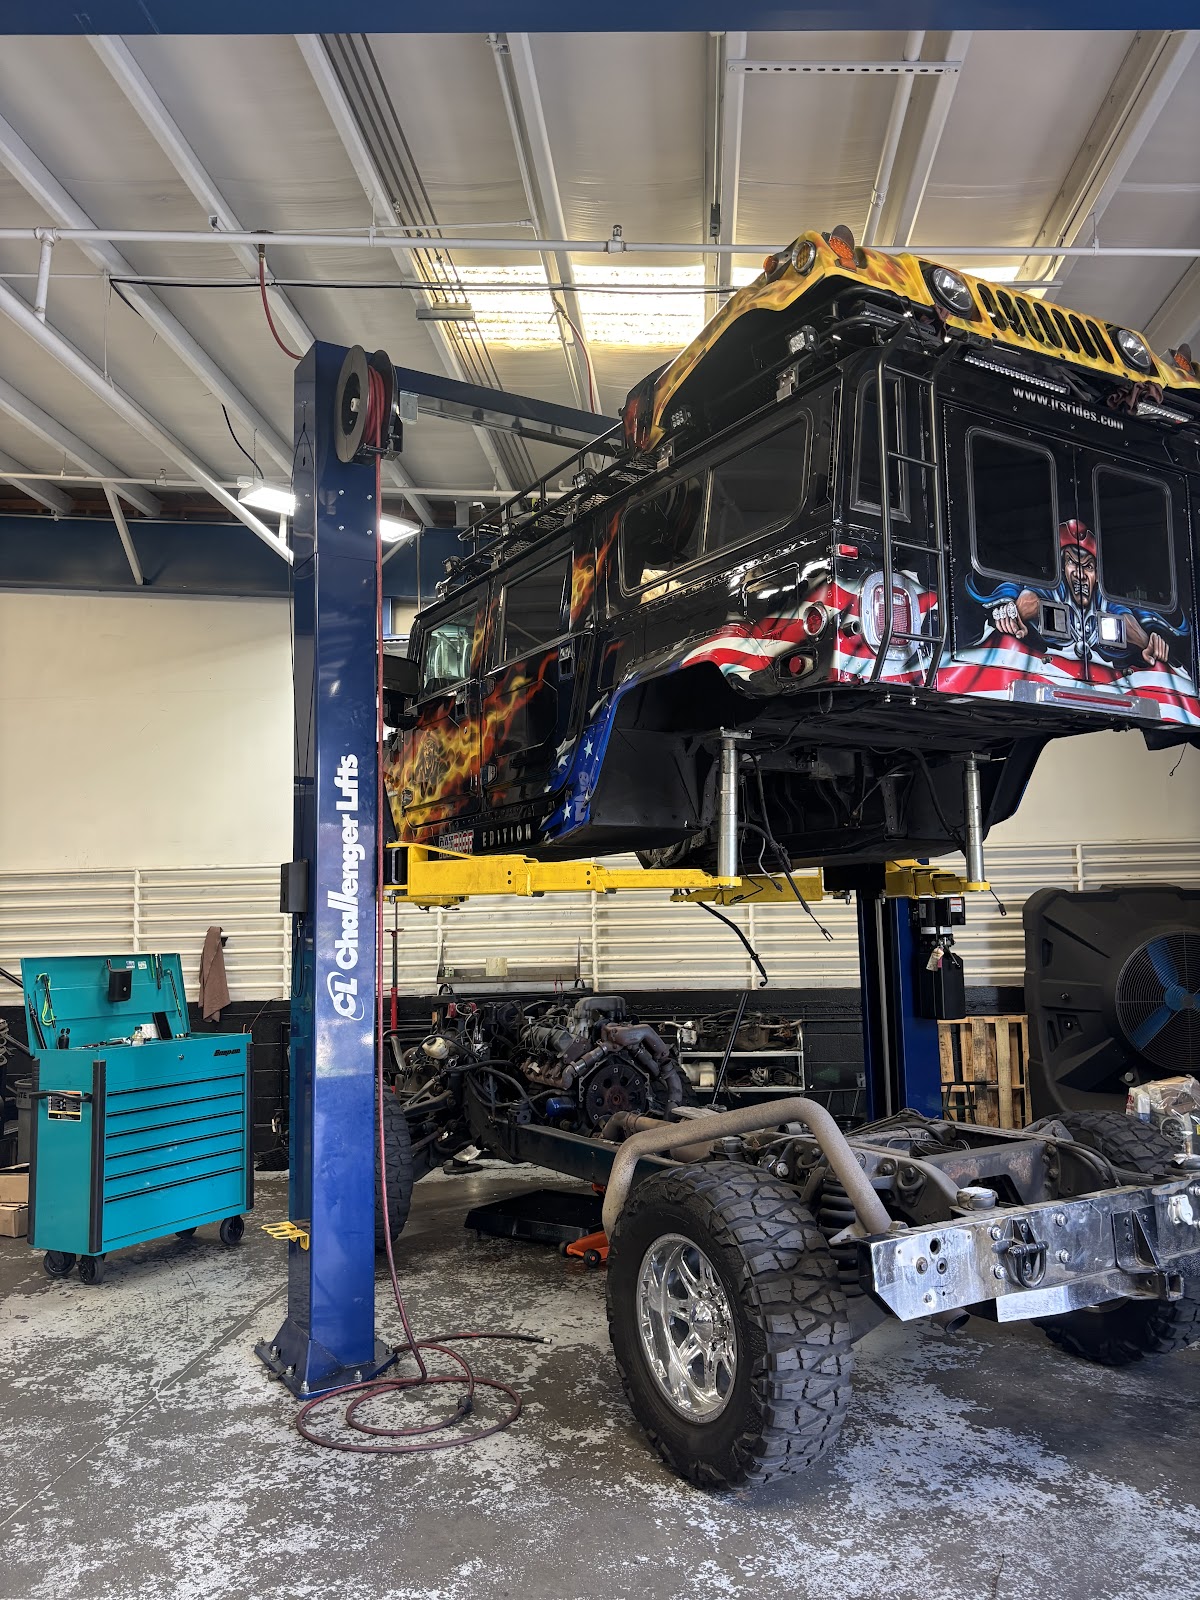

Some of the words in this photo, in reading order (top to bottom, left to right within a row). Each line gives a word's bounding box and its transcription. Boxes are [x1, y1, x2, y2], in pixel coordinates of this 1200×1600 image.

[1012, 387, 1124, 430] www.jrsrides.com
[334, 753, 359, 811] Lifts
[482, 823, 532, 848] EDITION
[327, 813, 366, 970] Challenger
